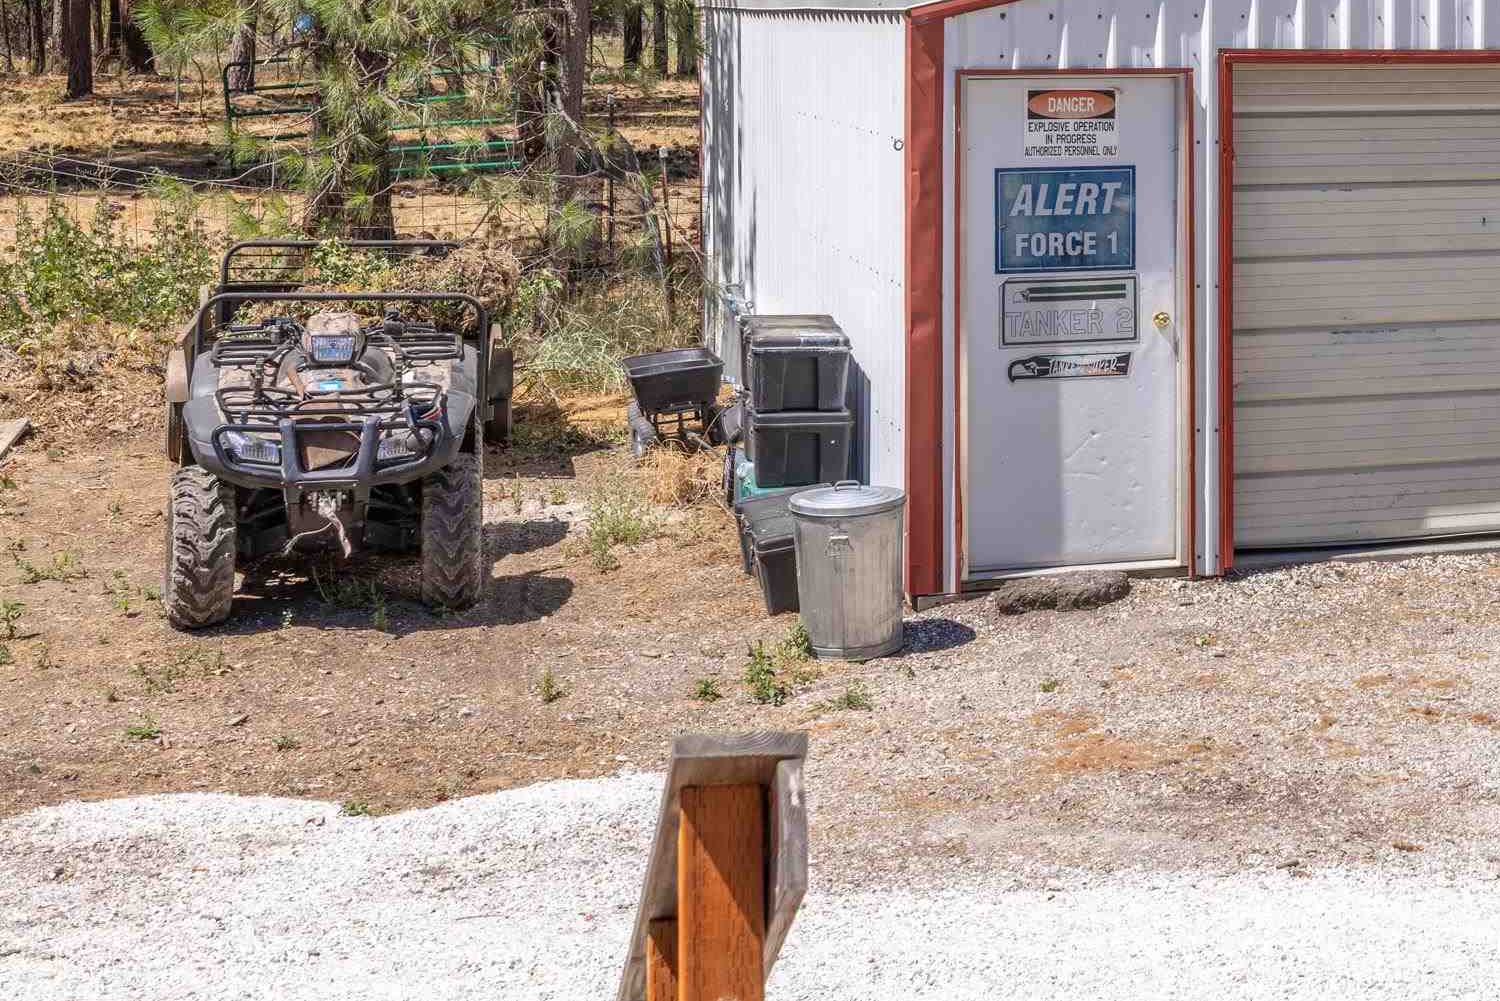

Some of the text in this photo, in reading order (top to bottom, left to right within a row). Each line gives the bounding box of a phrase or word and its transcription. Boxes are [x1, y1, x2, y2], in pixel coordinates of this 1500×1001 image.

[1048, 97, 1095, 112] DANGER
[1028, 121, 1115, 132] EXPLOSIVE OPERATION
[1045, 133, 1097, 144] IN PROGRESS
[1024, 145, 1118, 156] AUTHORIZED PERSONNEL ONLY
[1009, 180, 1122, 217] ALERT
[1015, 231, 1119, 258] FORCE 1
[1005, 307, 1133, 337] TANKER 2
